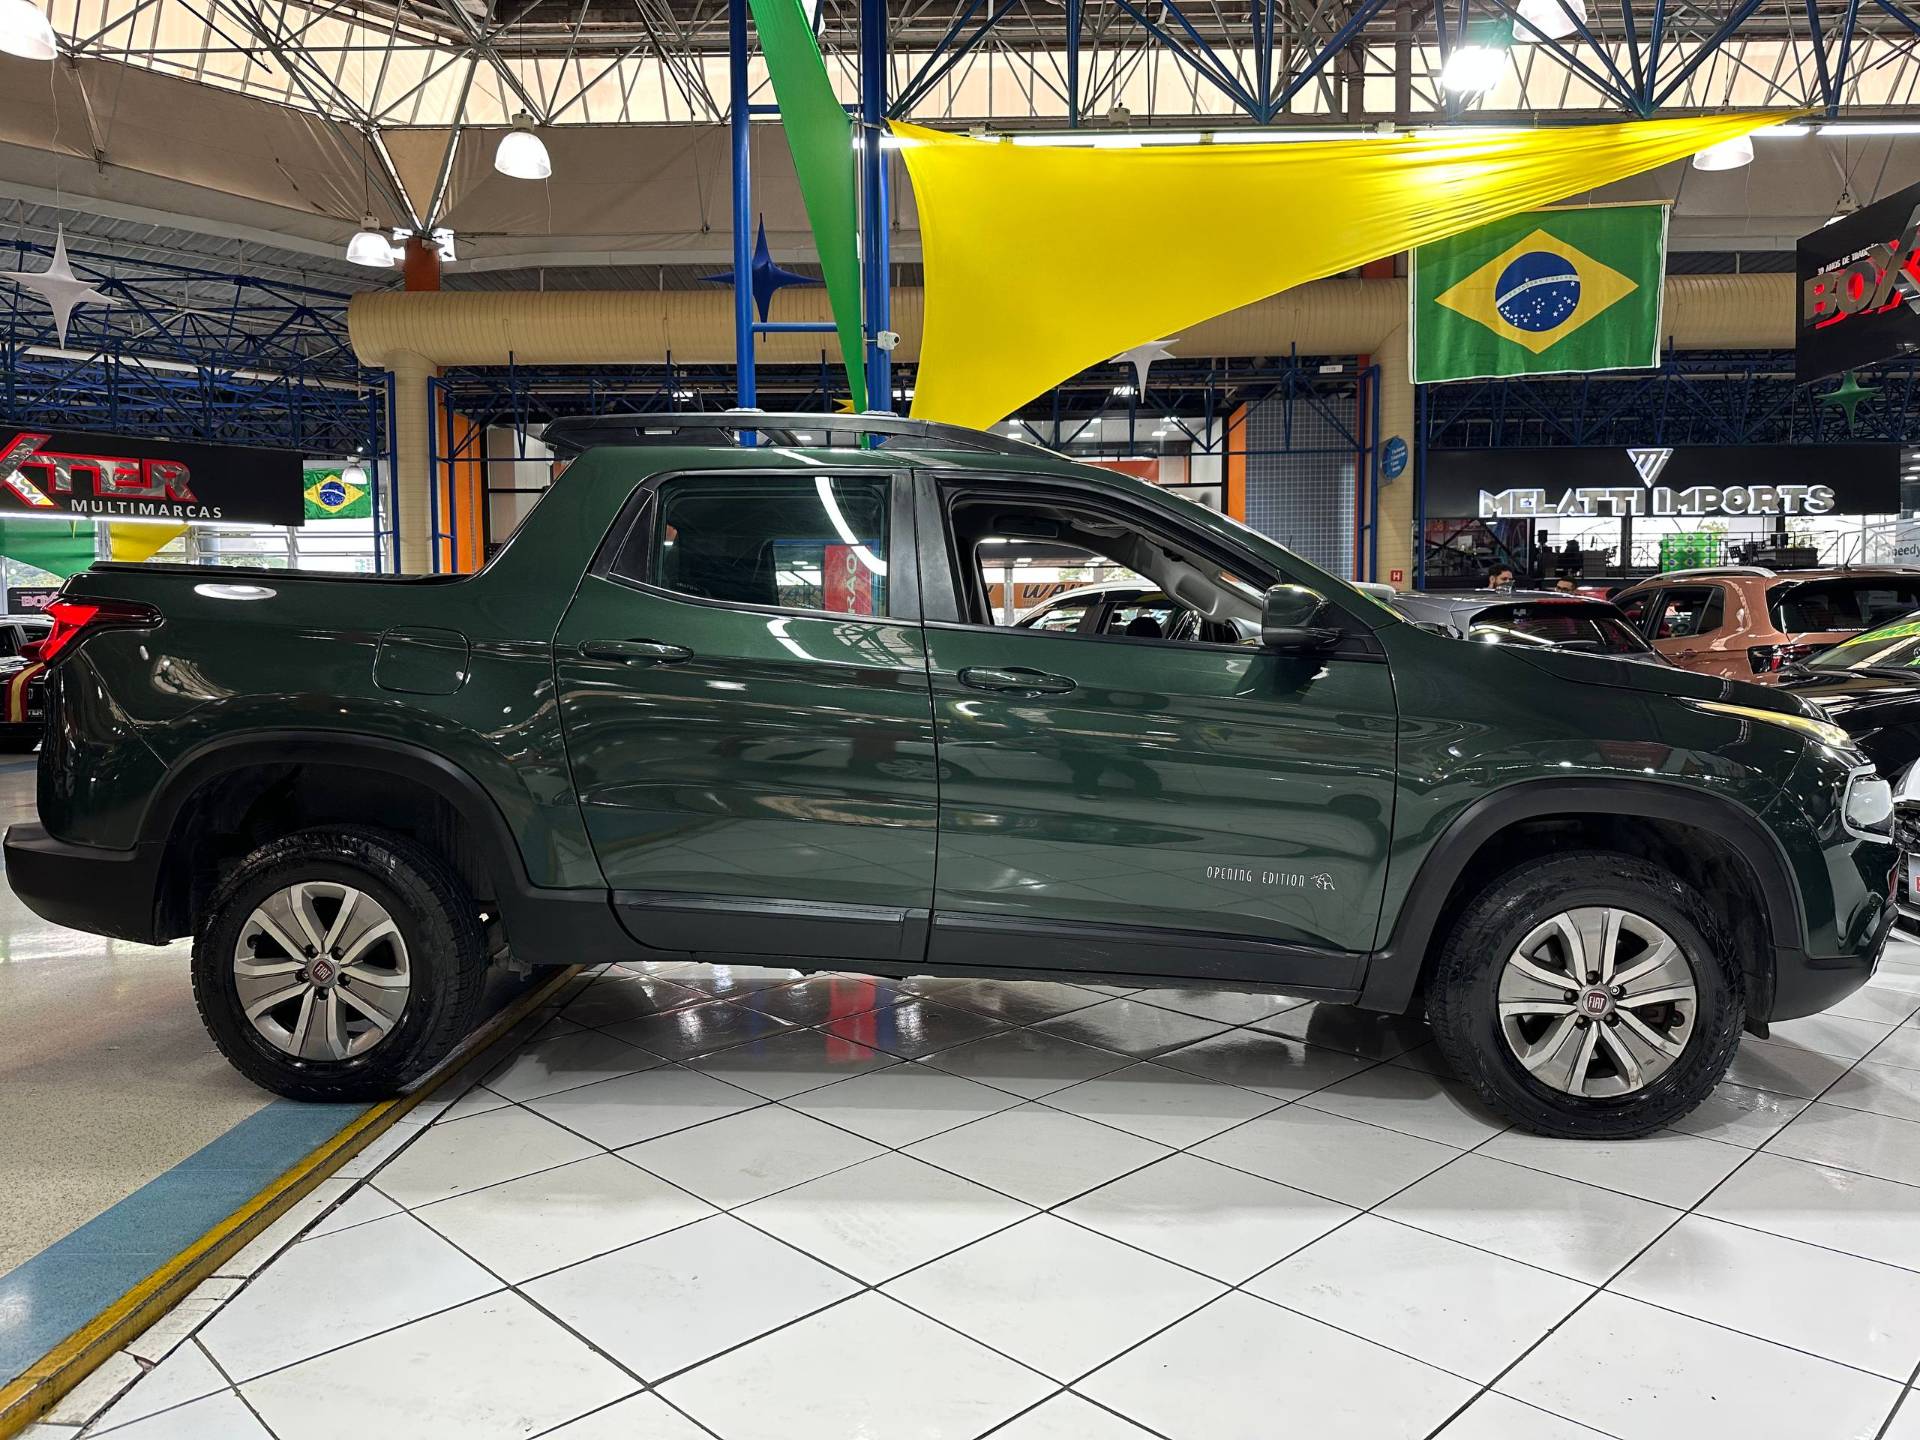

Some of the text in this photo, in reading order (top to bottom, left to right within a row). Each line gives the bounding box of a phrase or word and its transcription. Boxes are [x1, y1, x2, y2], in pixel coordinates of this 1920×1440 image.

[71, 499, 222, 519] MULTIMARCAS
[1479, 484, 1836, 517] MELATTI IMPORTS
[1206, 866, 1306, 887] OPENING EDITION
[314, 963, 331, 980] FIAT
[1588, 996, 1605, 1010] FIAT
